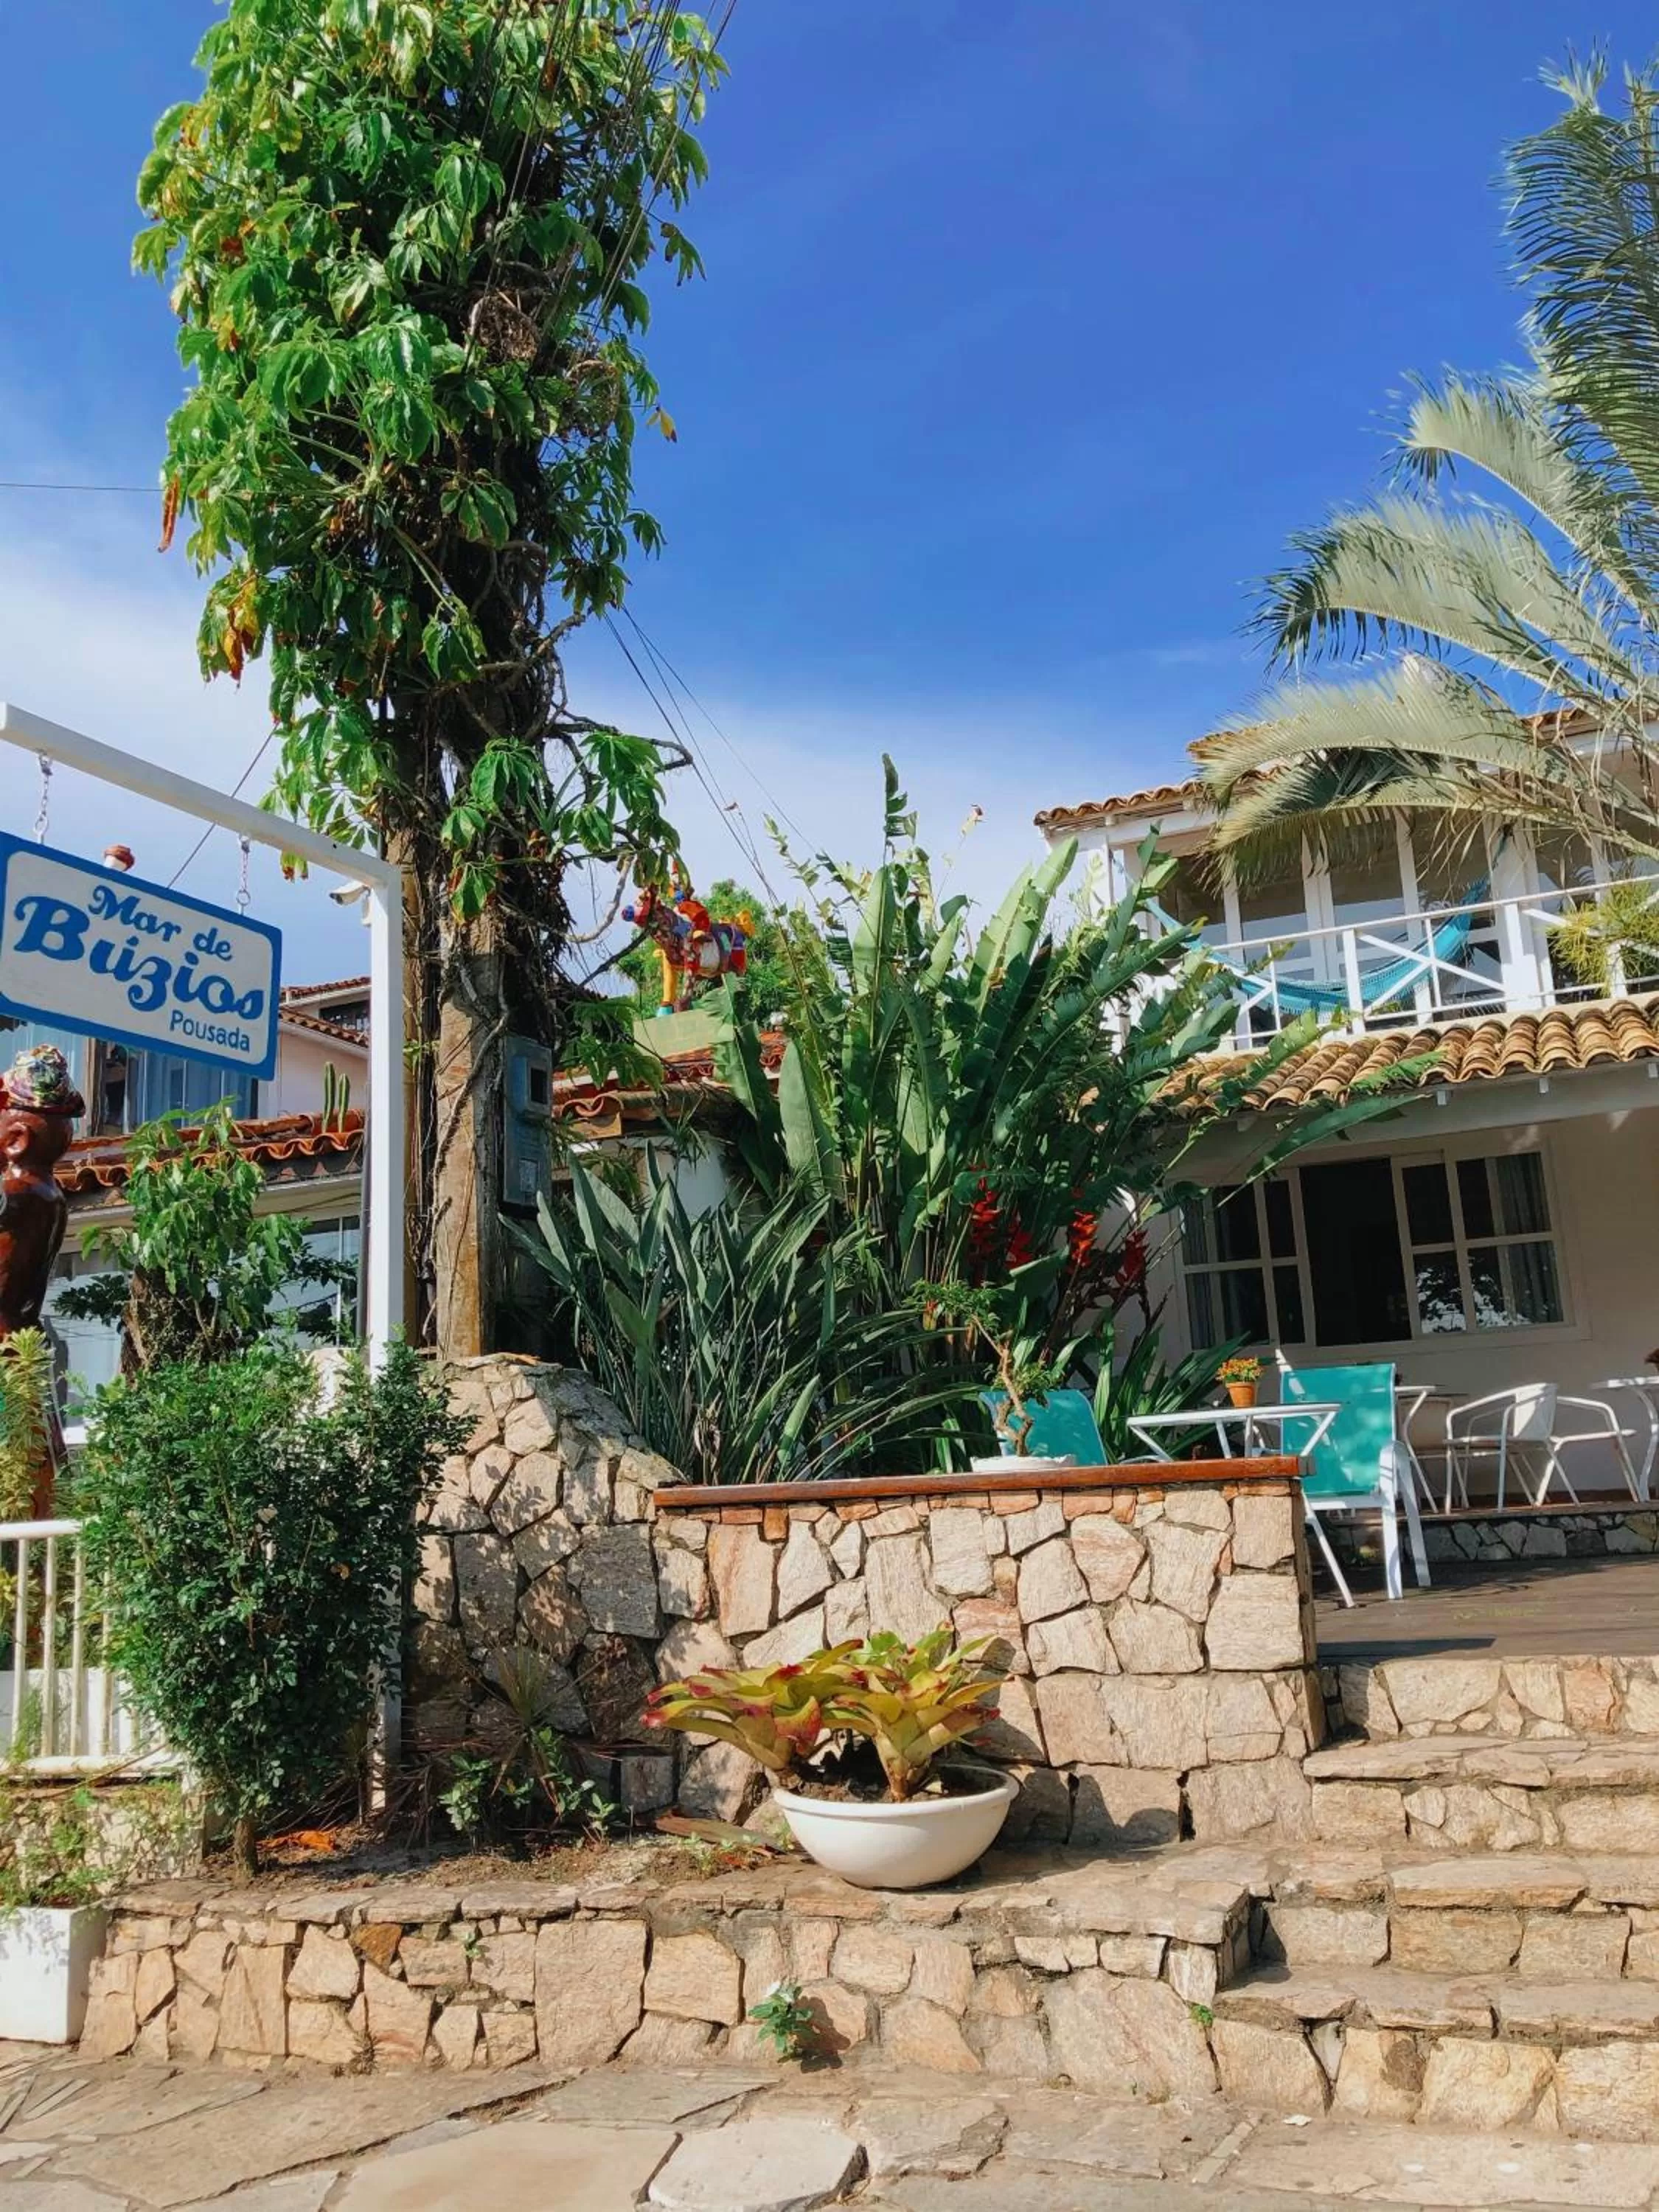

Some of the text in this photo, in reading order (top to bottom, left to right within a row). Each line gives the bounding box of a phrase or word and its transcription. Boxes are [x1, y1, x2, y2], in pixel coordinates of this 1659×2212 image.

[88, 885, 232, 961] Mar de
[170, 1009, 250, 1052] Pousada
